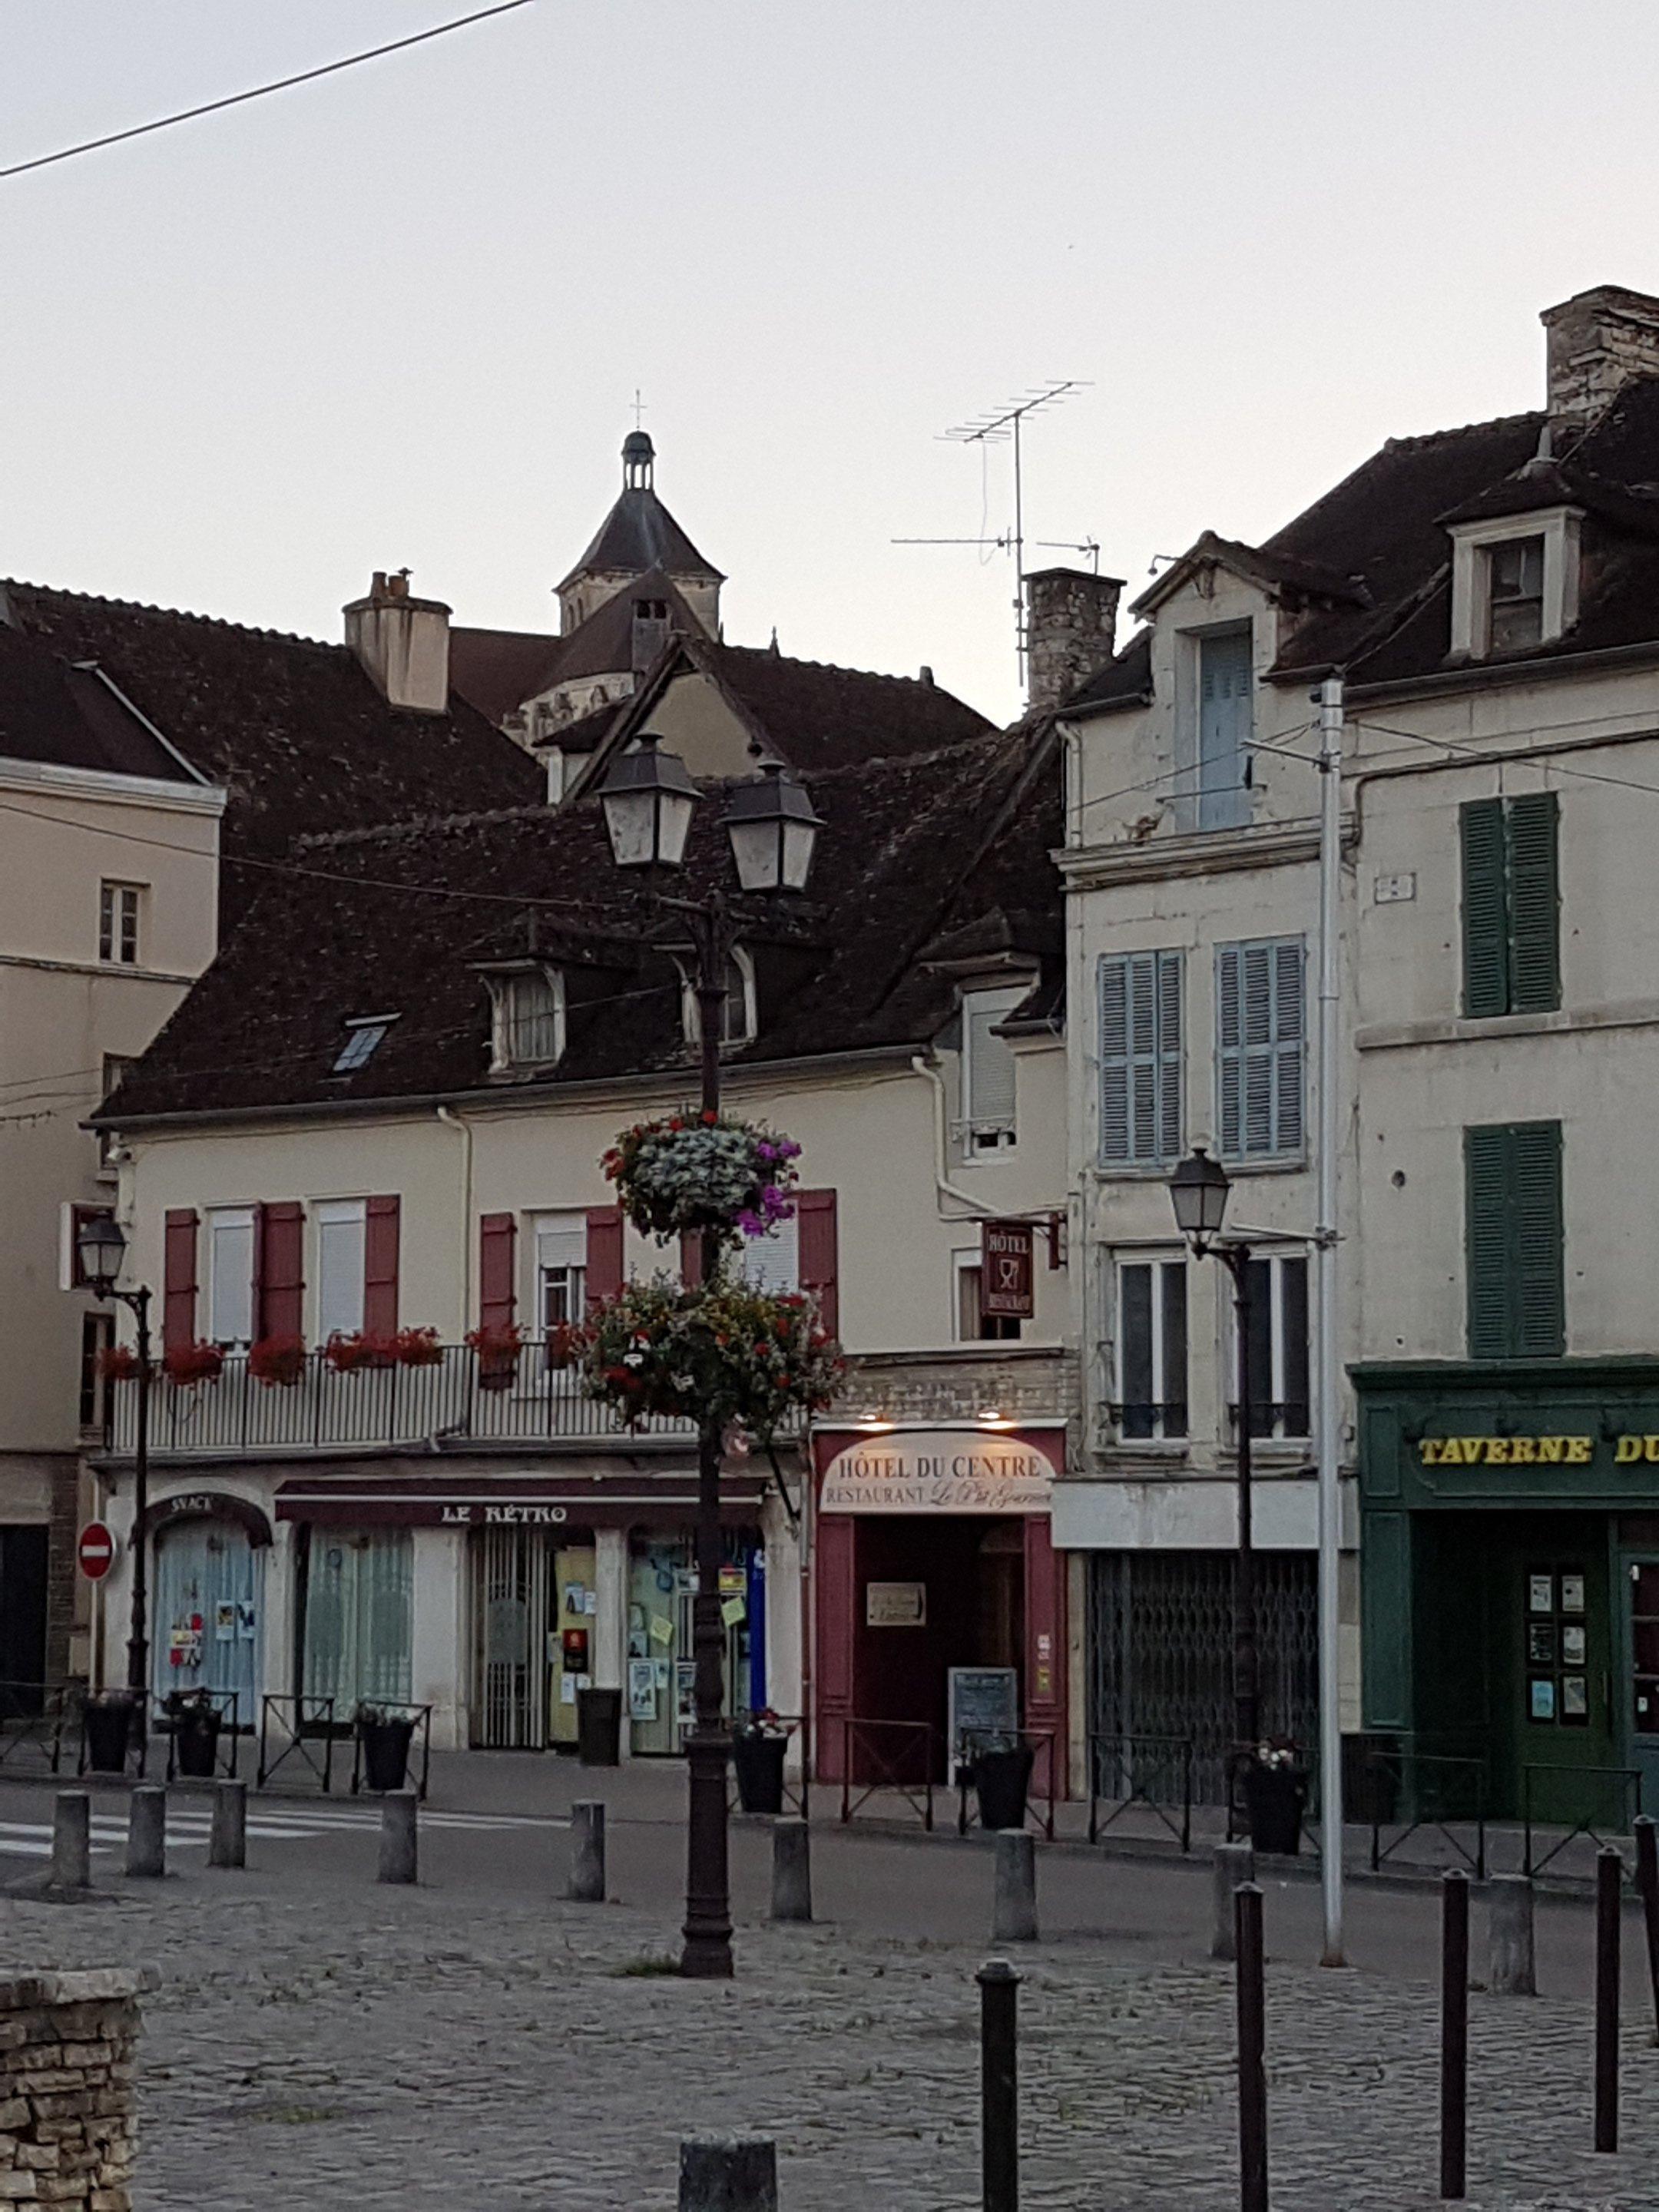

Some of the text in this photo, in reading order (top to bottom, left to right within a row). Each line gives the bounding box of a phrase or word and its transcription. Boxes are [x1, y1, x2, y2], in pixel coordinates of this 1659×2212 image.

[988, 1230, 1030, 1254] HÔTEL
[1419, 1435, 1593, 1465] TAVERNE
[839, 1452, 1041, 1479] HÔTEL DU CENTRE
[171, 1496, 214, 1513] SNACK
[826, 1485, 924, 1504] RESTAURANT
[441, 1504, 567, 1523] LE RÉTRO
